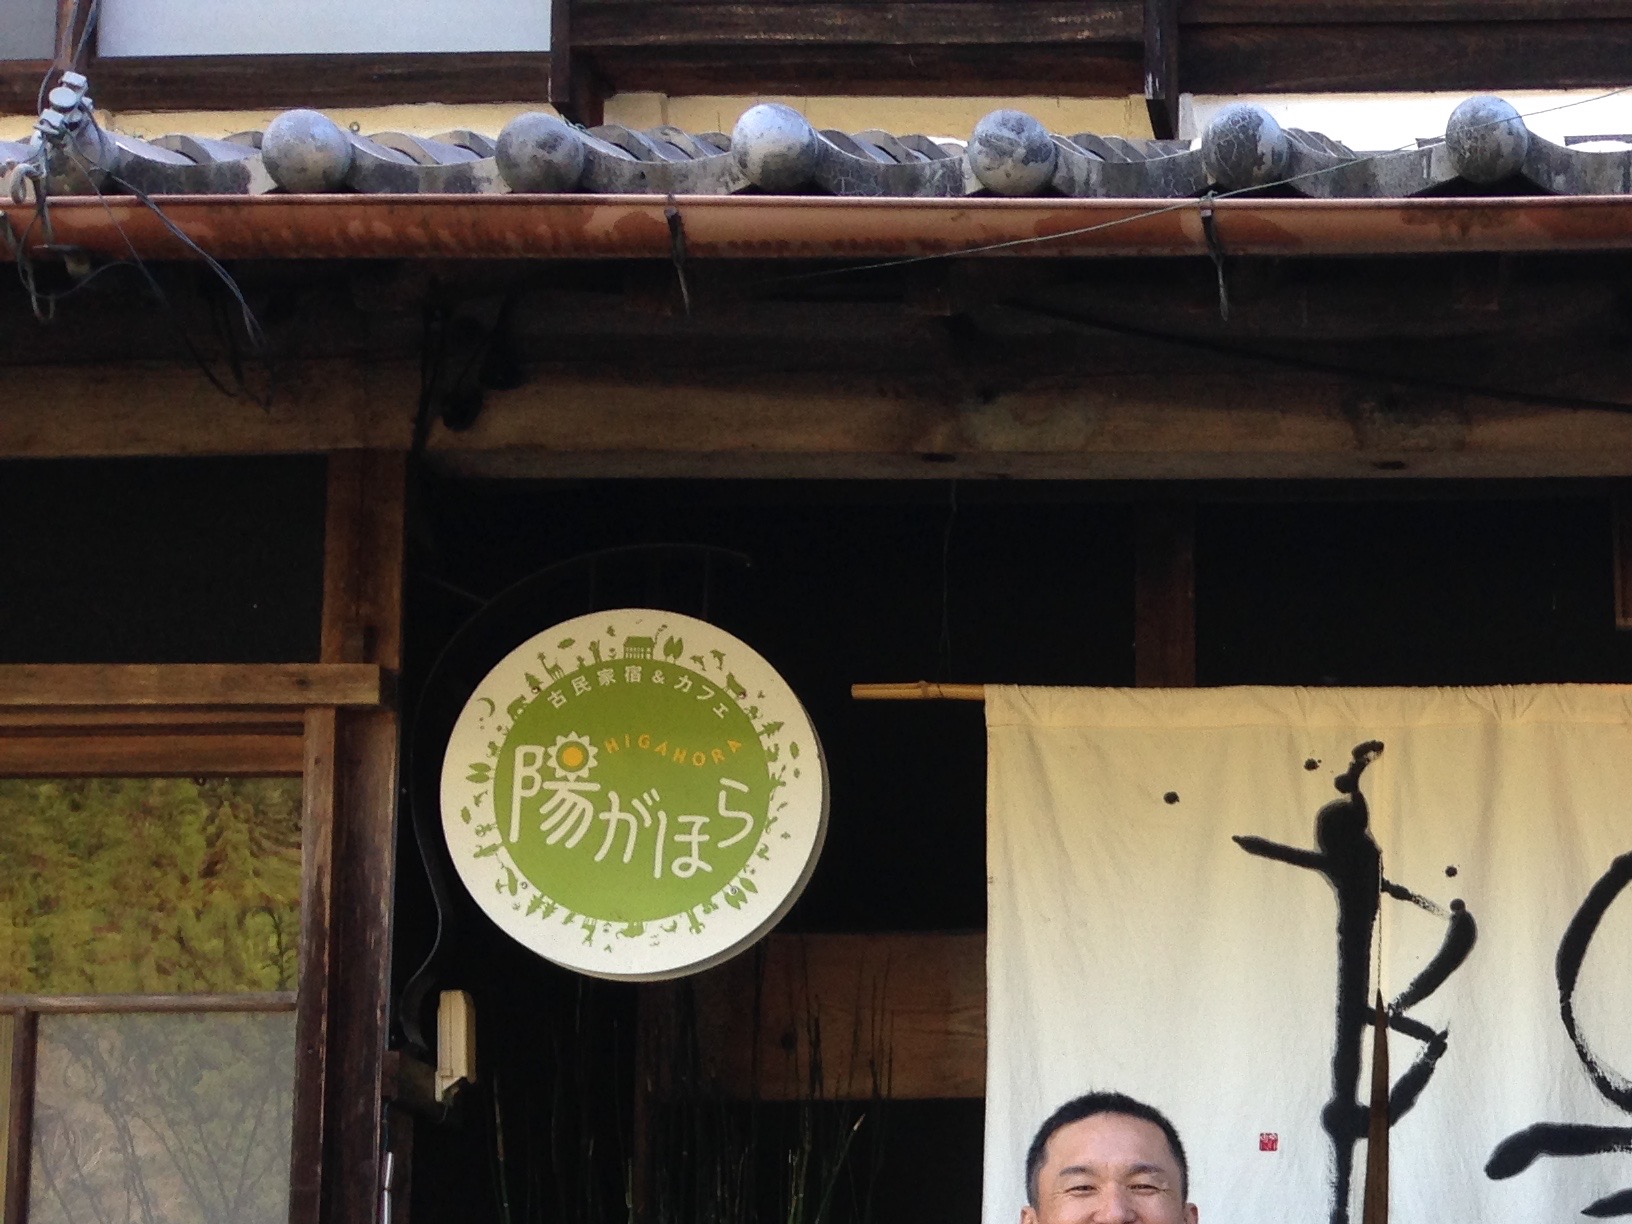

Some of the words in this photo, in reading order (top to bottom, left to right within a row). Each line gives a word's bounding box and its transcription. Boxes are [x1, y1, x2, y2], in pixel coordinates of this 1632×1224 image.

[547, 665, 729, 719] 古民家宿&カフェ
[603, 733, 742, 767] HIGAHORA
[508, 731, 754, 879] 陽がほら
